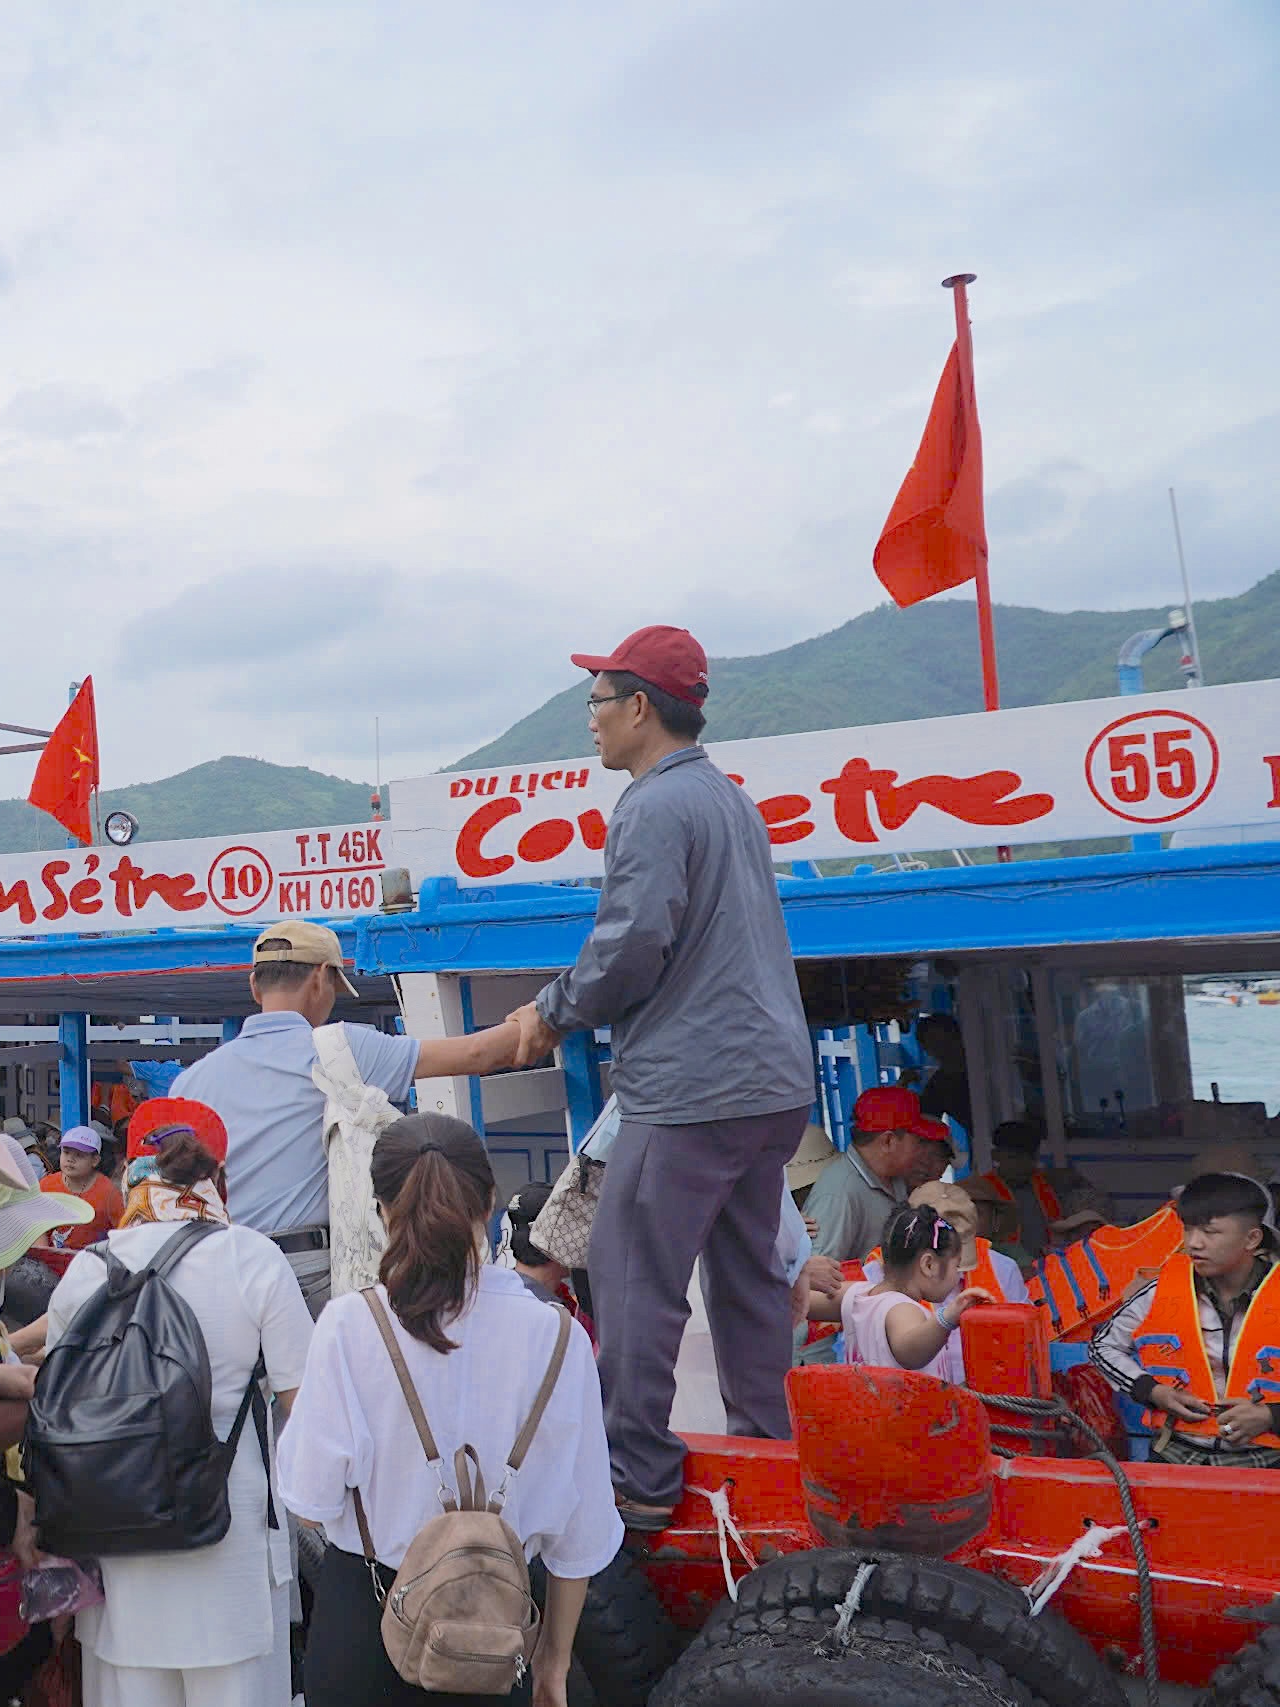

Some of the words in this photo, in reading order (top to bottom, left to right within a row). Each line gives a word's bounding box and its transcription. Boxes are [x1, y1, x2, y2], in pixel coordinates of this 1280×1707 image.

[450, 775, 499, 798] DU
[510, 768, 590, 798] LỊCH
[1107, 729, 1197, 804] 55
[338, 829, 384, 864] 45K
[220, 863, 263, 901] 10
[279, 880, 311, 913] KH
[320, 876, 375, 910] 0160
